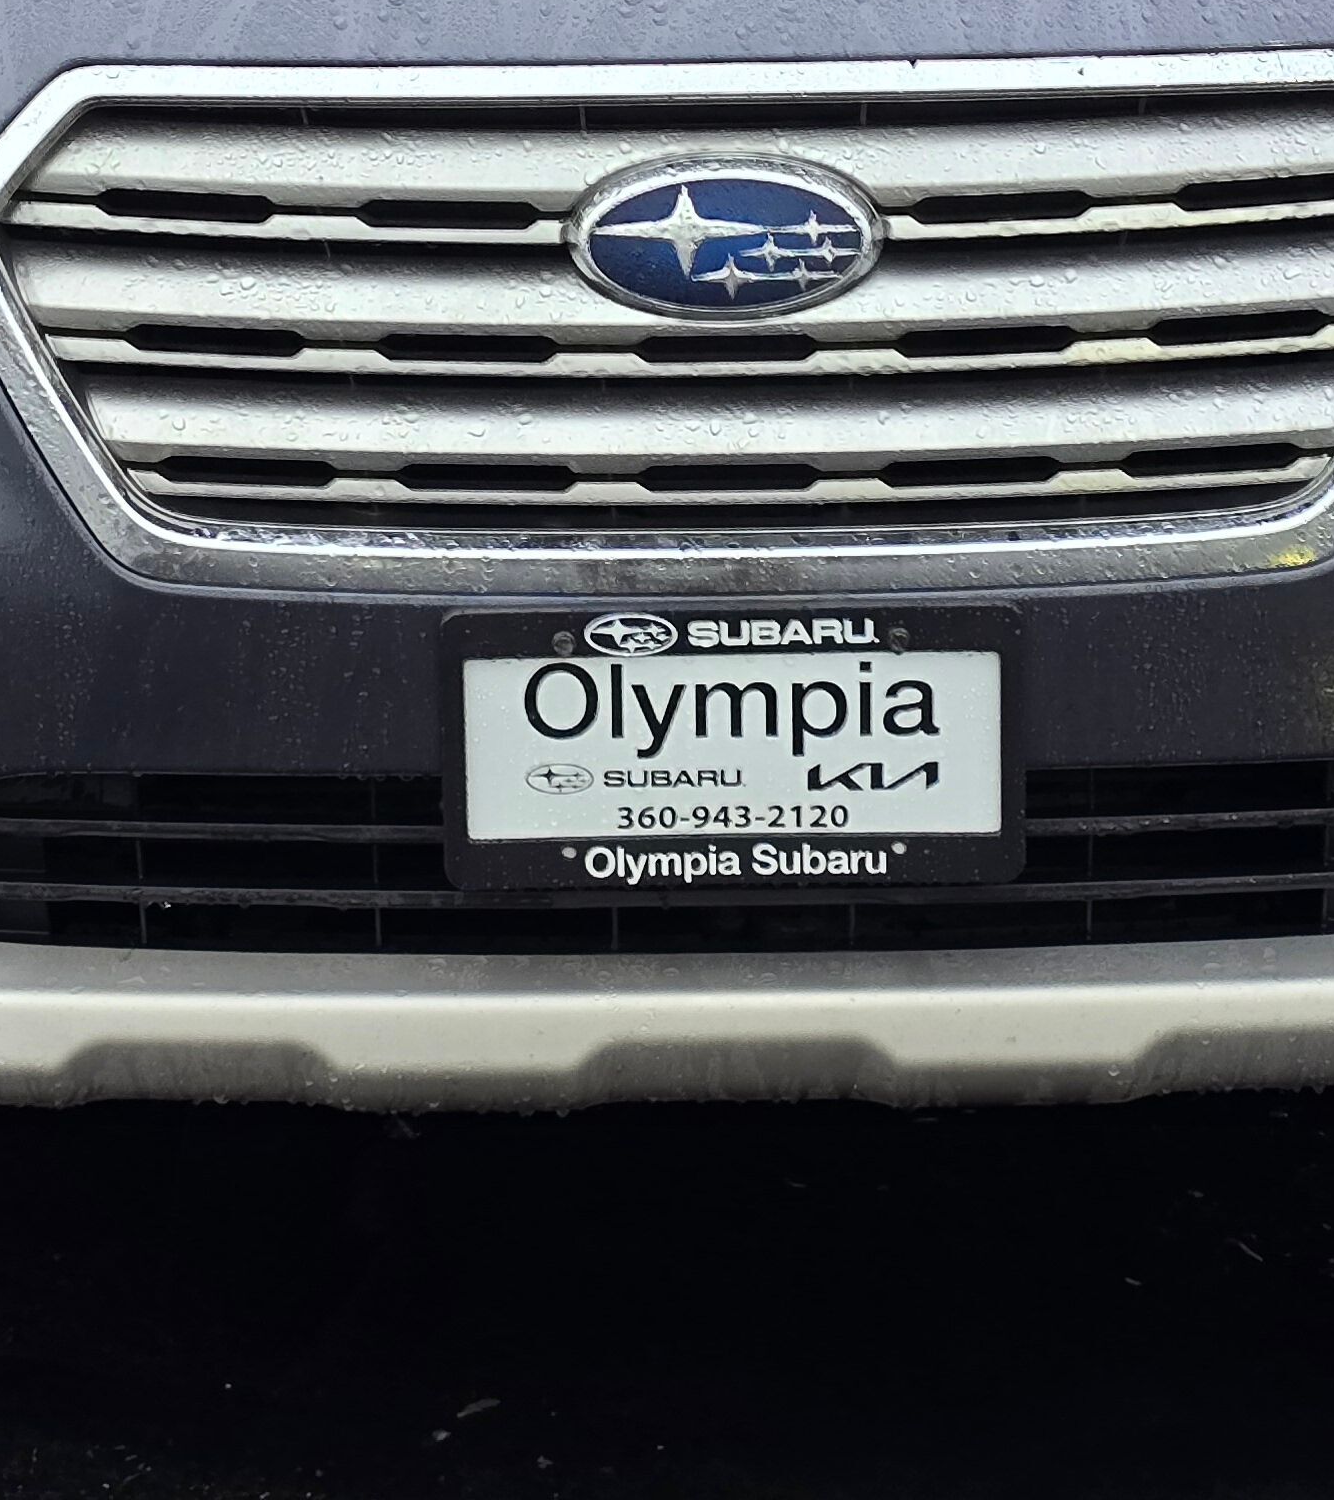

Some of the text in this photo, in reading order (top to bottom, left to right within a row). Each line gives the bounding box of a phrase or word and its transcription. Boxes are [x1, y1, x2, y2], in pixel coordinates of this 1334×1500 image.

[687, 617, 875, 648] SUBARU
[524, 660, 941, 760] Olympia
[603, 761, 940, 792] SUBARU KIA
[617, 804, 849, 830] 360-943-2120
[584, 842, 888, 886] Olympia Subaru
